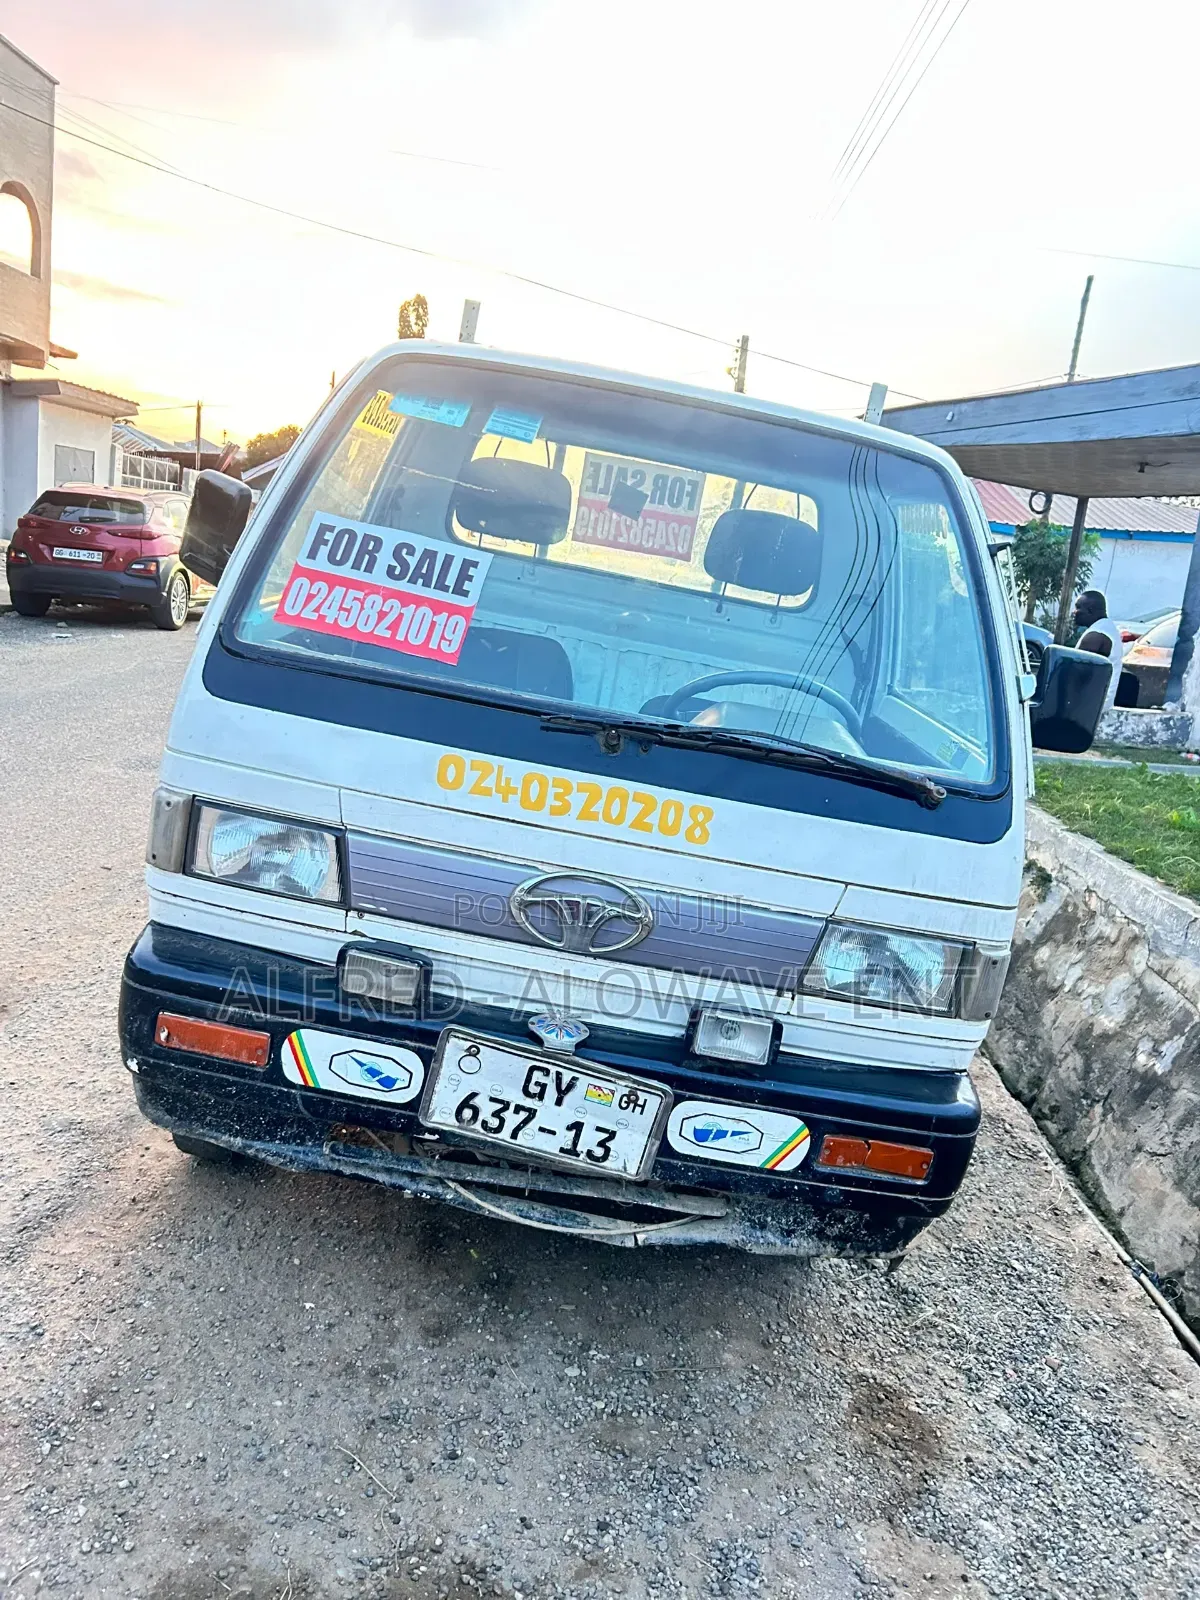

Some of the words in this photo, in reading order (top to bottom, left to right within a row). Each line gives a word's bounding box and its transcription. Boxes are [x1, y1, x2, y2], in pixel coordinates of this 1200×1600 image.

[306, 522, 384, 574] FOR
[386, 542, 480, 598] SALE
[284, 577, 467, 654] 0245821019
[436, 754, 714, 845] 0240320208
[455, 1091, 617, 1163] 637-13
[521, 1064, 580, 1108] GY
[618, 1092, 648, 1116] GH
